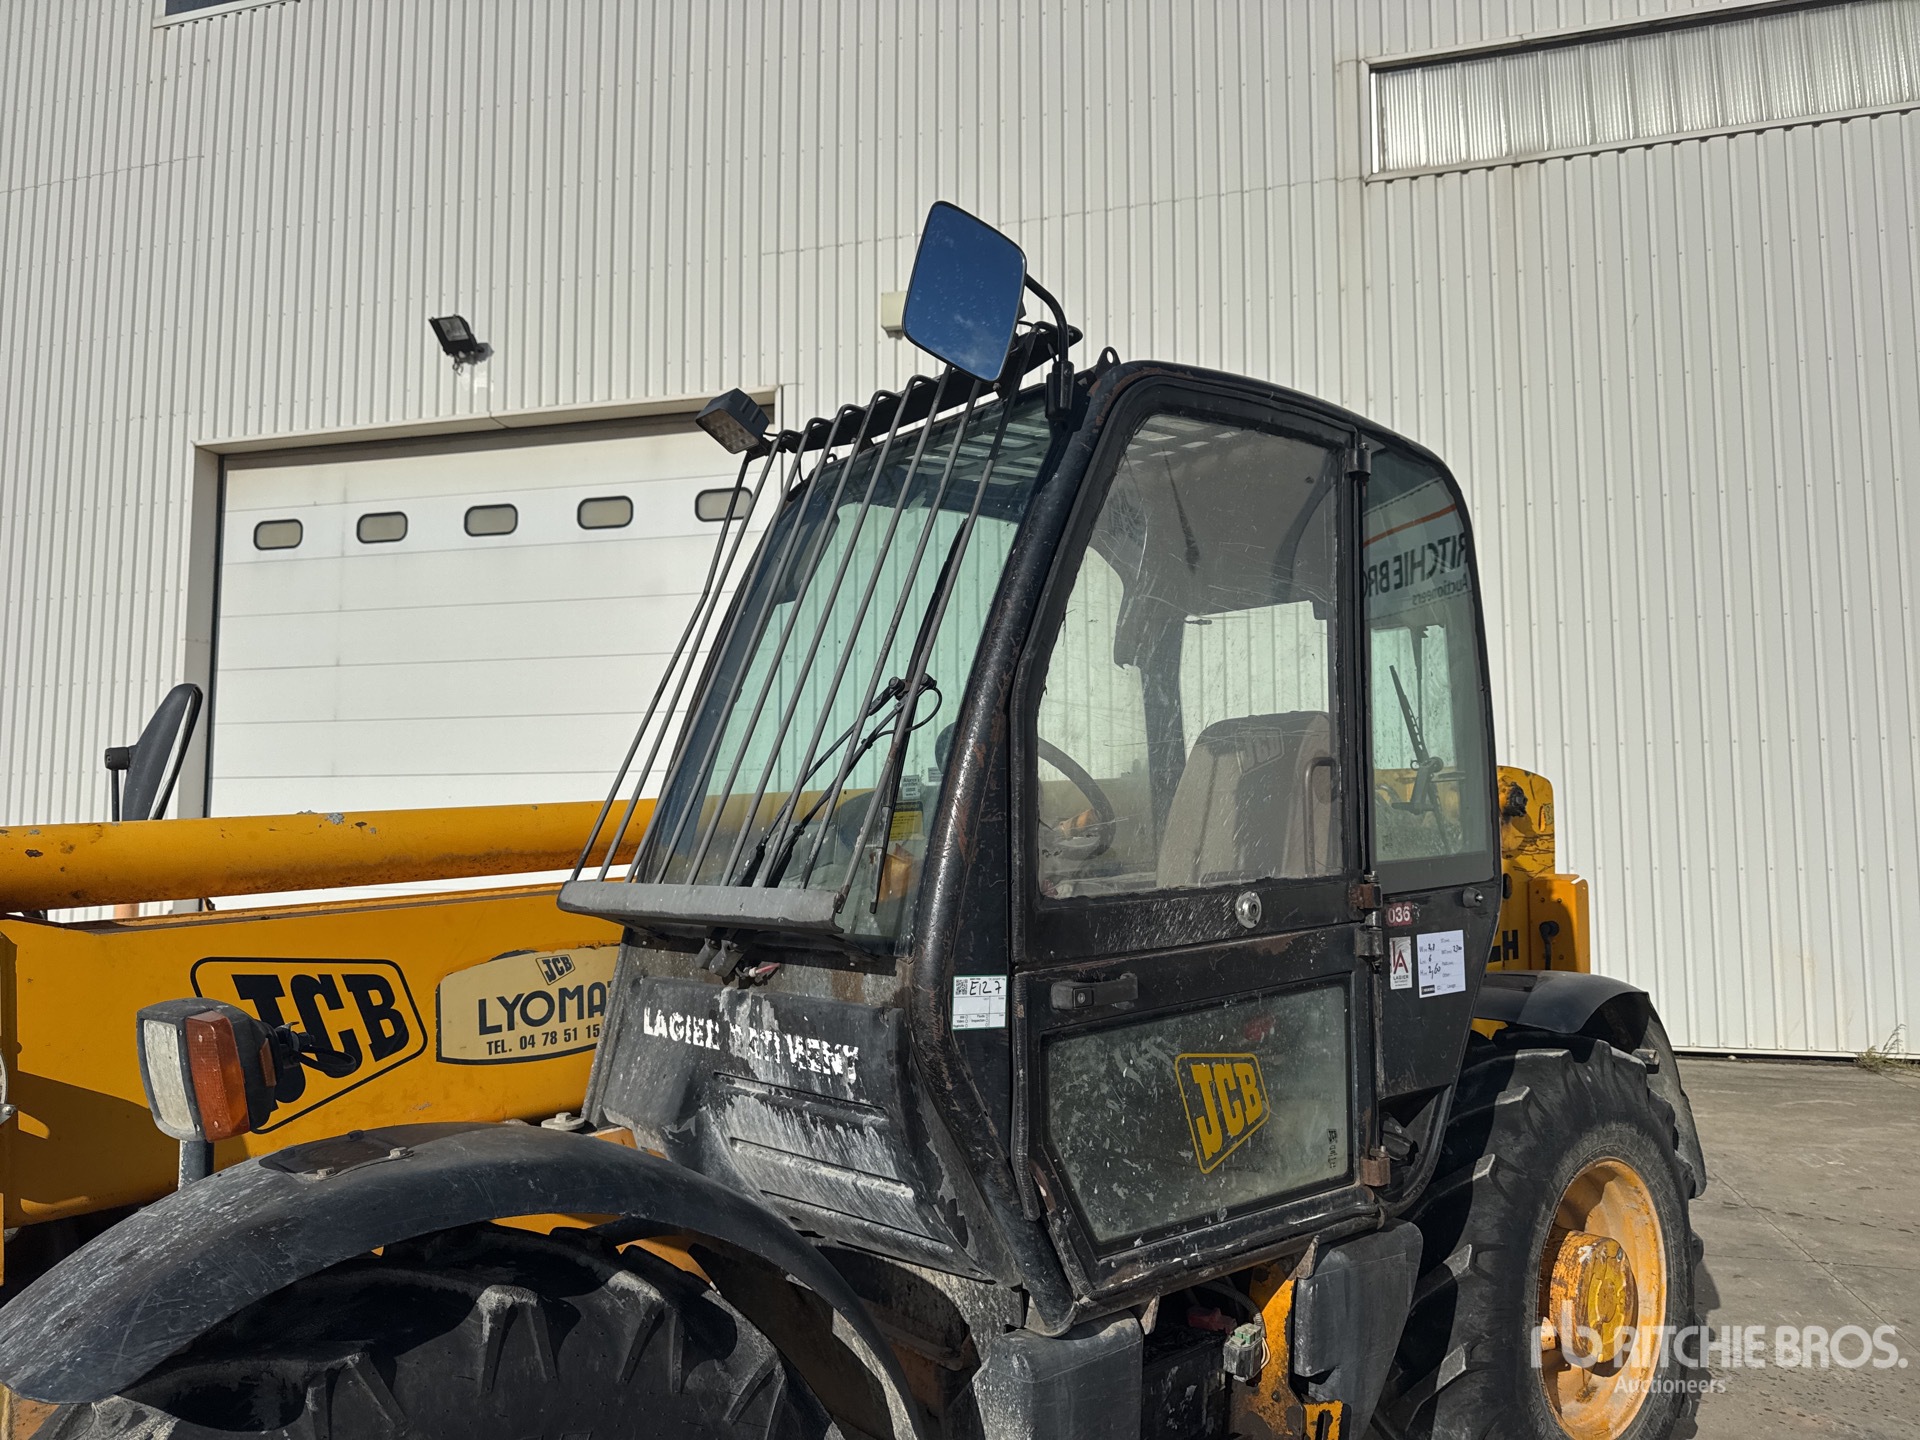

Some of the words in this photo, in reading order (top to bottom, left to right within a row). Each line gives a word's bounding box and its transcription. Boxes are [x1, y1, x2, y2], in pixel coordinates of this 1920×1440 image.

[1388, 905, 1411, 924] 036
[542, 956, 573, 983] JCB
[969, 979, 1002, 997] E127
[479, 981, 612, 1036] LYOMA
[231, 972, 410, 1111] JCB
[486, 1039, 513, 1056] TEL.
[519, 1034, 536, 1050] 04
[541, 1030, 558, 1047] 78
[563, 1027, 578, 1043] 51
[585, 1023, 601, 1039] 15
[1191, 1063, 1264, 1161] JCB
